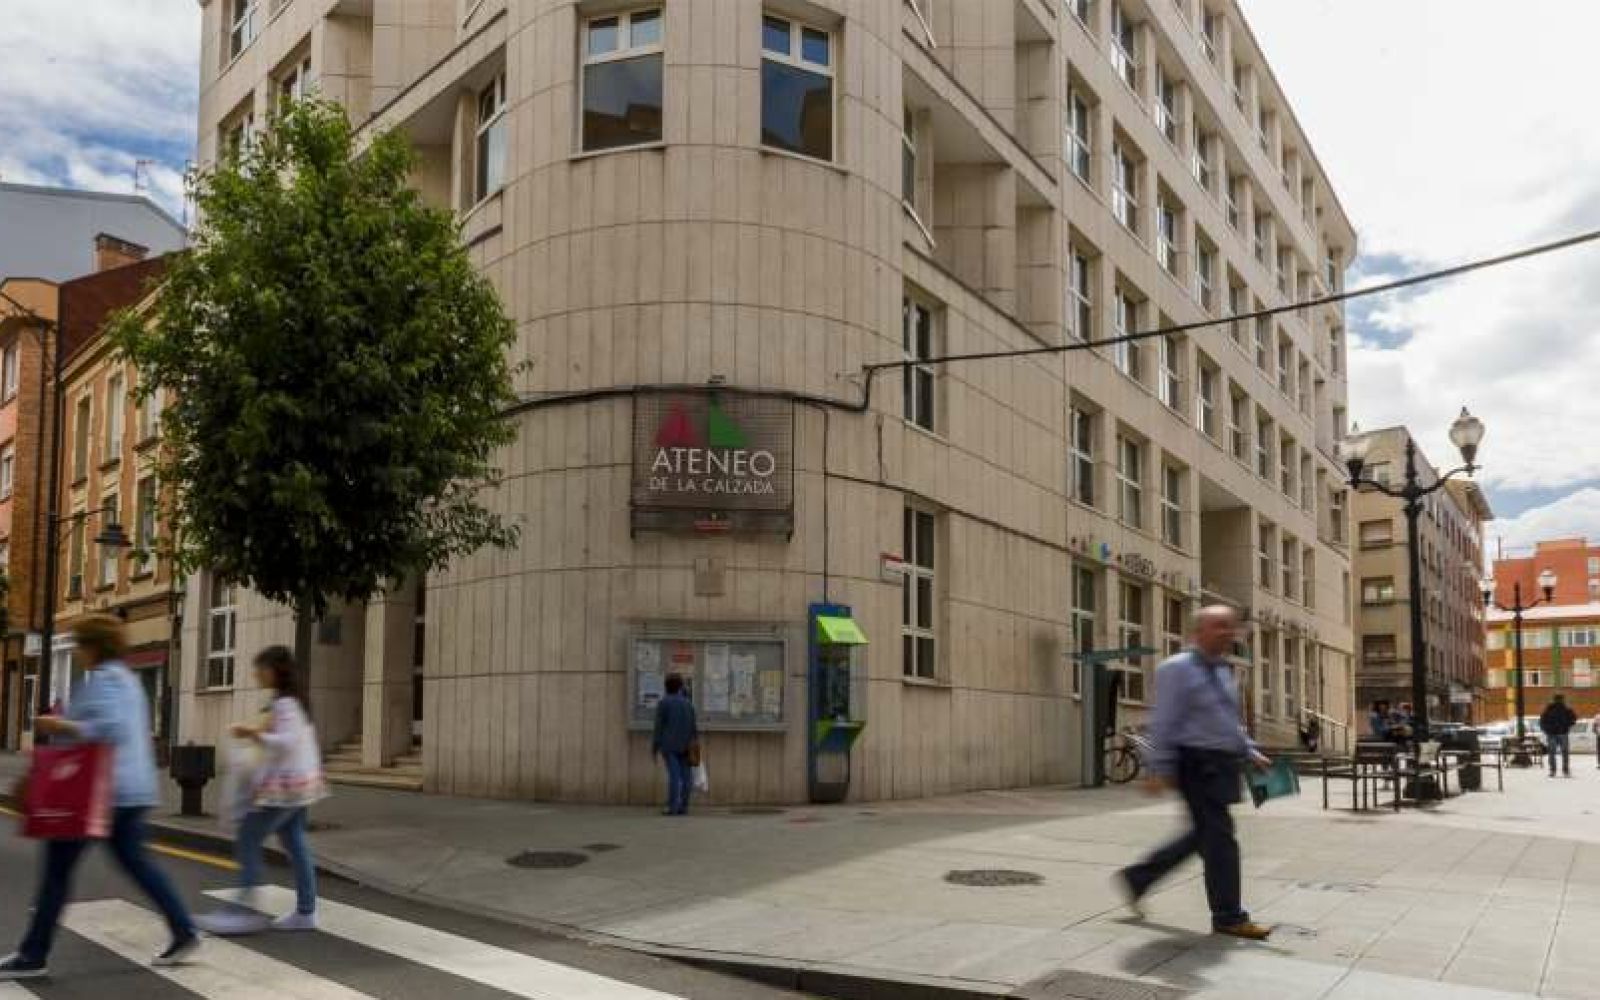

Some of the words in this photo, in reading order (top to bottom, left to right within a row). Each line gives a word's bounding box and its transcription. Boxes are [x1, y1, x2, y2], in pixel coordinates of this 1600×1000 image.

[651, 447, 775, 476] ATENEO
[650, 477, 669, 491] DE
[677, 478, 697, 492] LA
[703, 478, 775, 494] CALZADA
